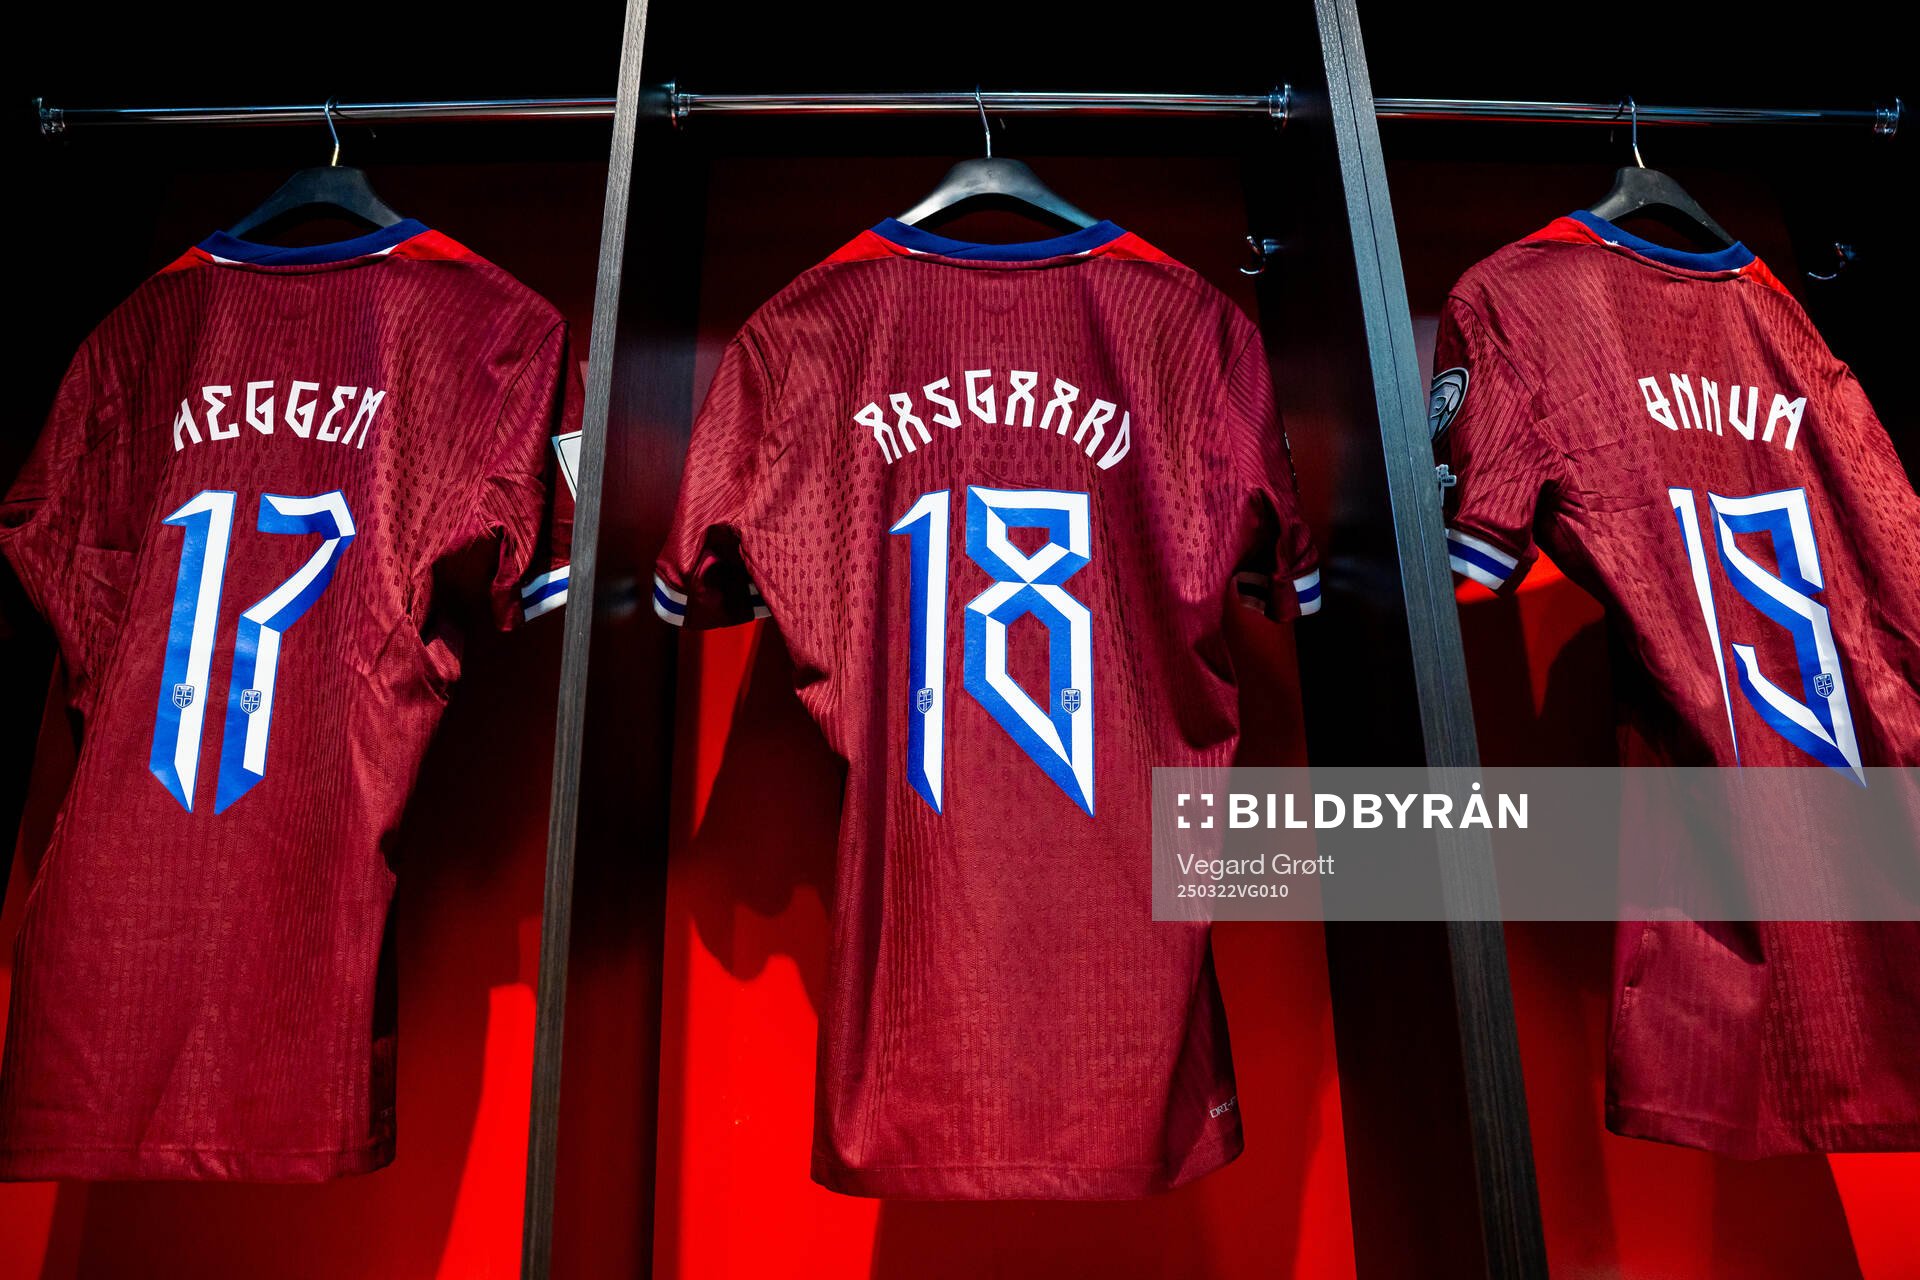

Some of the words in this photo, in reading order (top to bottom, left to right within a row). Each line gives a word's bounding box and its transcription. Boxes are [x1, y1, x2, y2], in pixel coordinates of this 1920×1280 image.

[853, 369, 1131, 471] AASGAARD
[149, 489, 357, 816] 17
[889, 485, 1096, 818] 18
